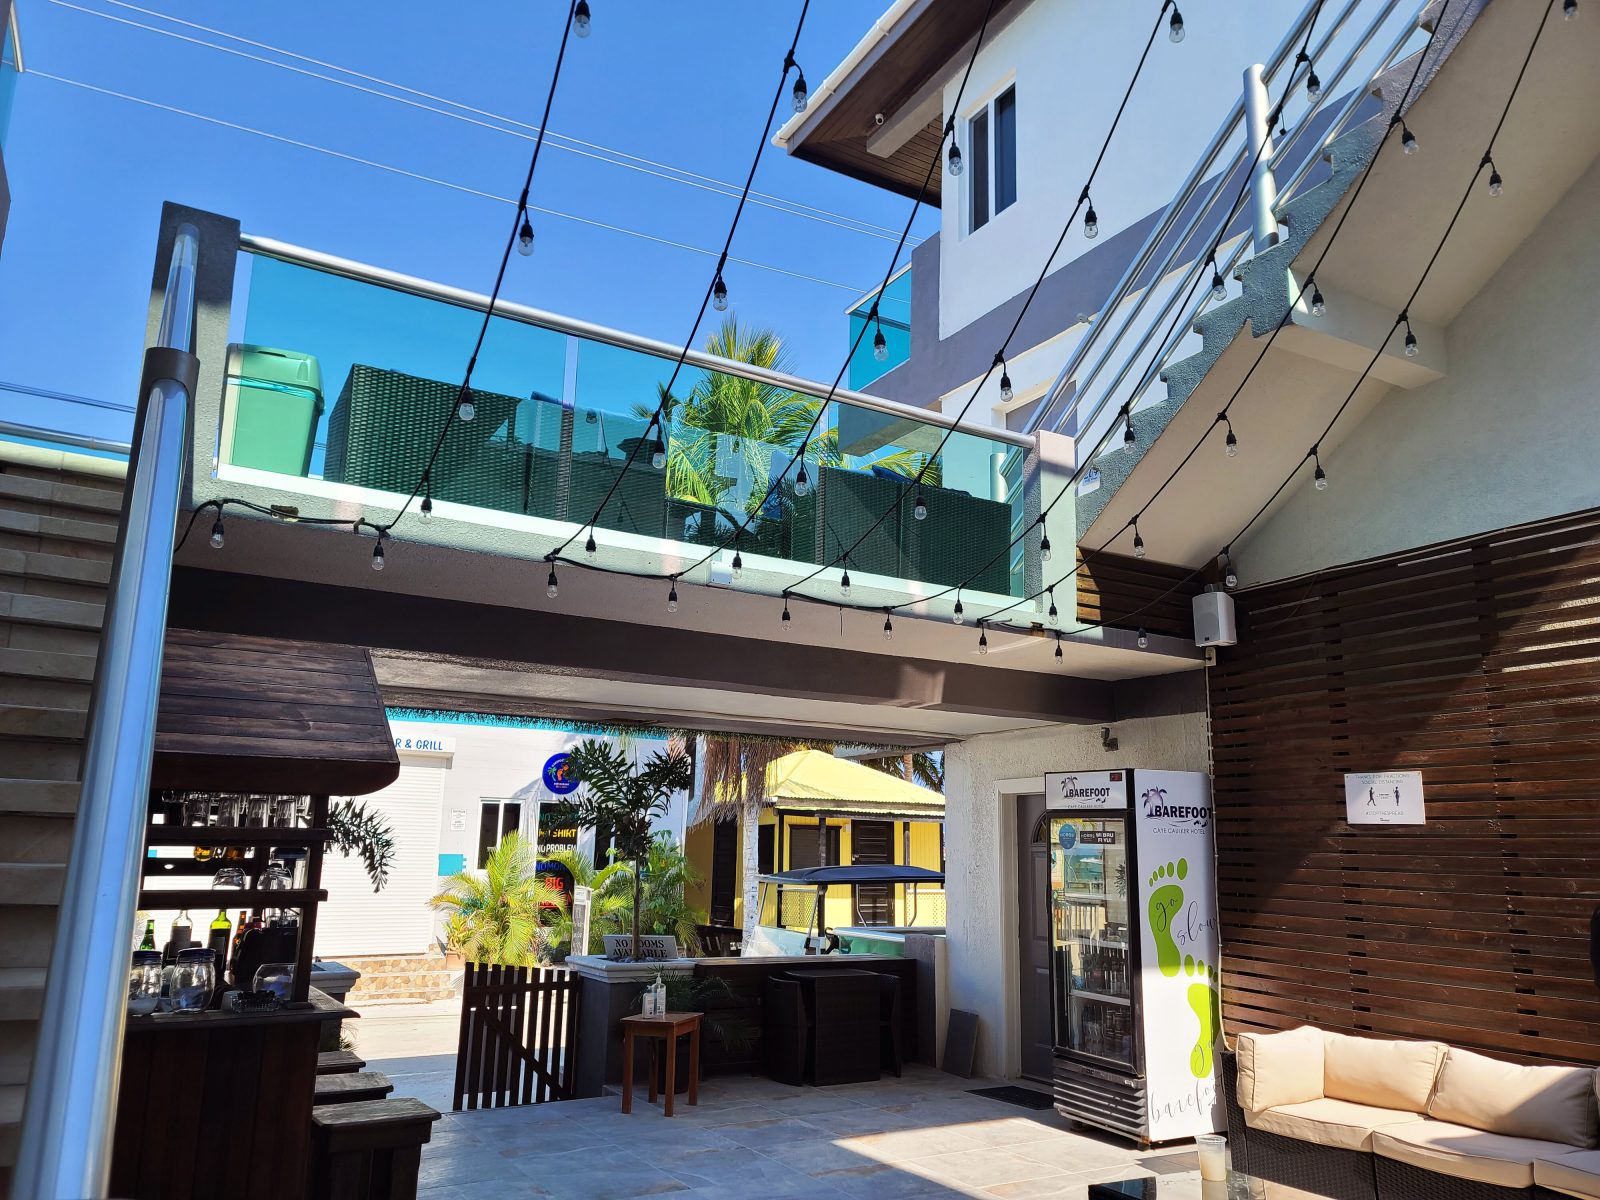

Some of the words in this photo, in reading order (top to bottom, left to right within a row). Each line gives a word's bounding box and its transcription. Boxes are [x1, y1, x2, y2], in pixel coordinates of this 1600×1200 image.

[405, 739, 411, 748] &
[416, 740, 443, 750] GRILL
[1069, 787, 1110, 798] BAREFOOT
[1155, 805, 1212, 819] BAREFOOT
[552, 829, 577, 838] SHIRT
[546, 844, 577, 853] PROBLEM
[615, 939, 628, 948] NO
[631, 939, 664, 949] OOMS
[613, 948, 668, 958] AVAIABLE
